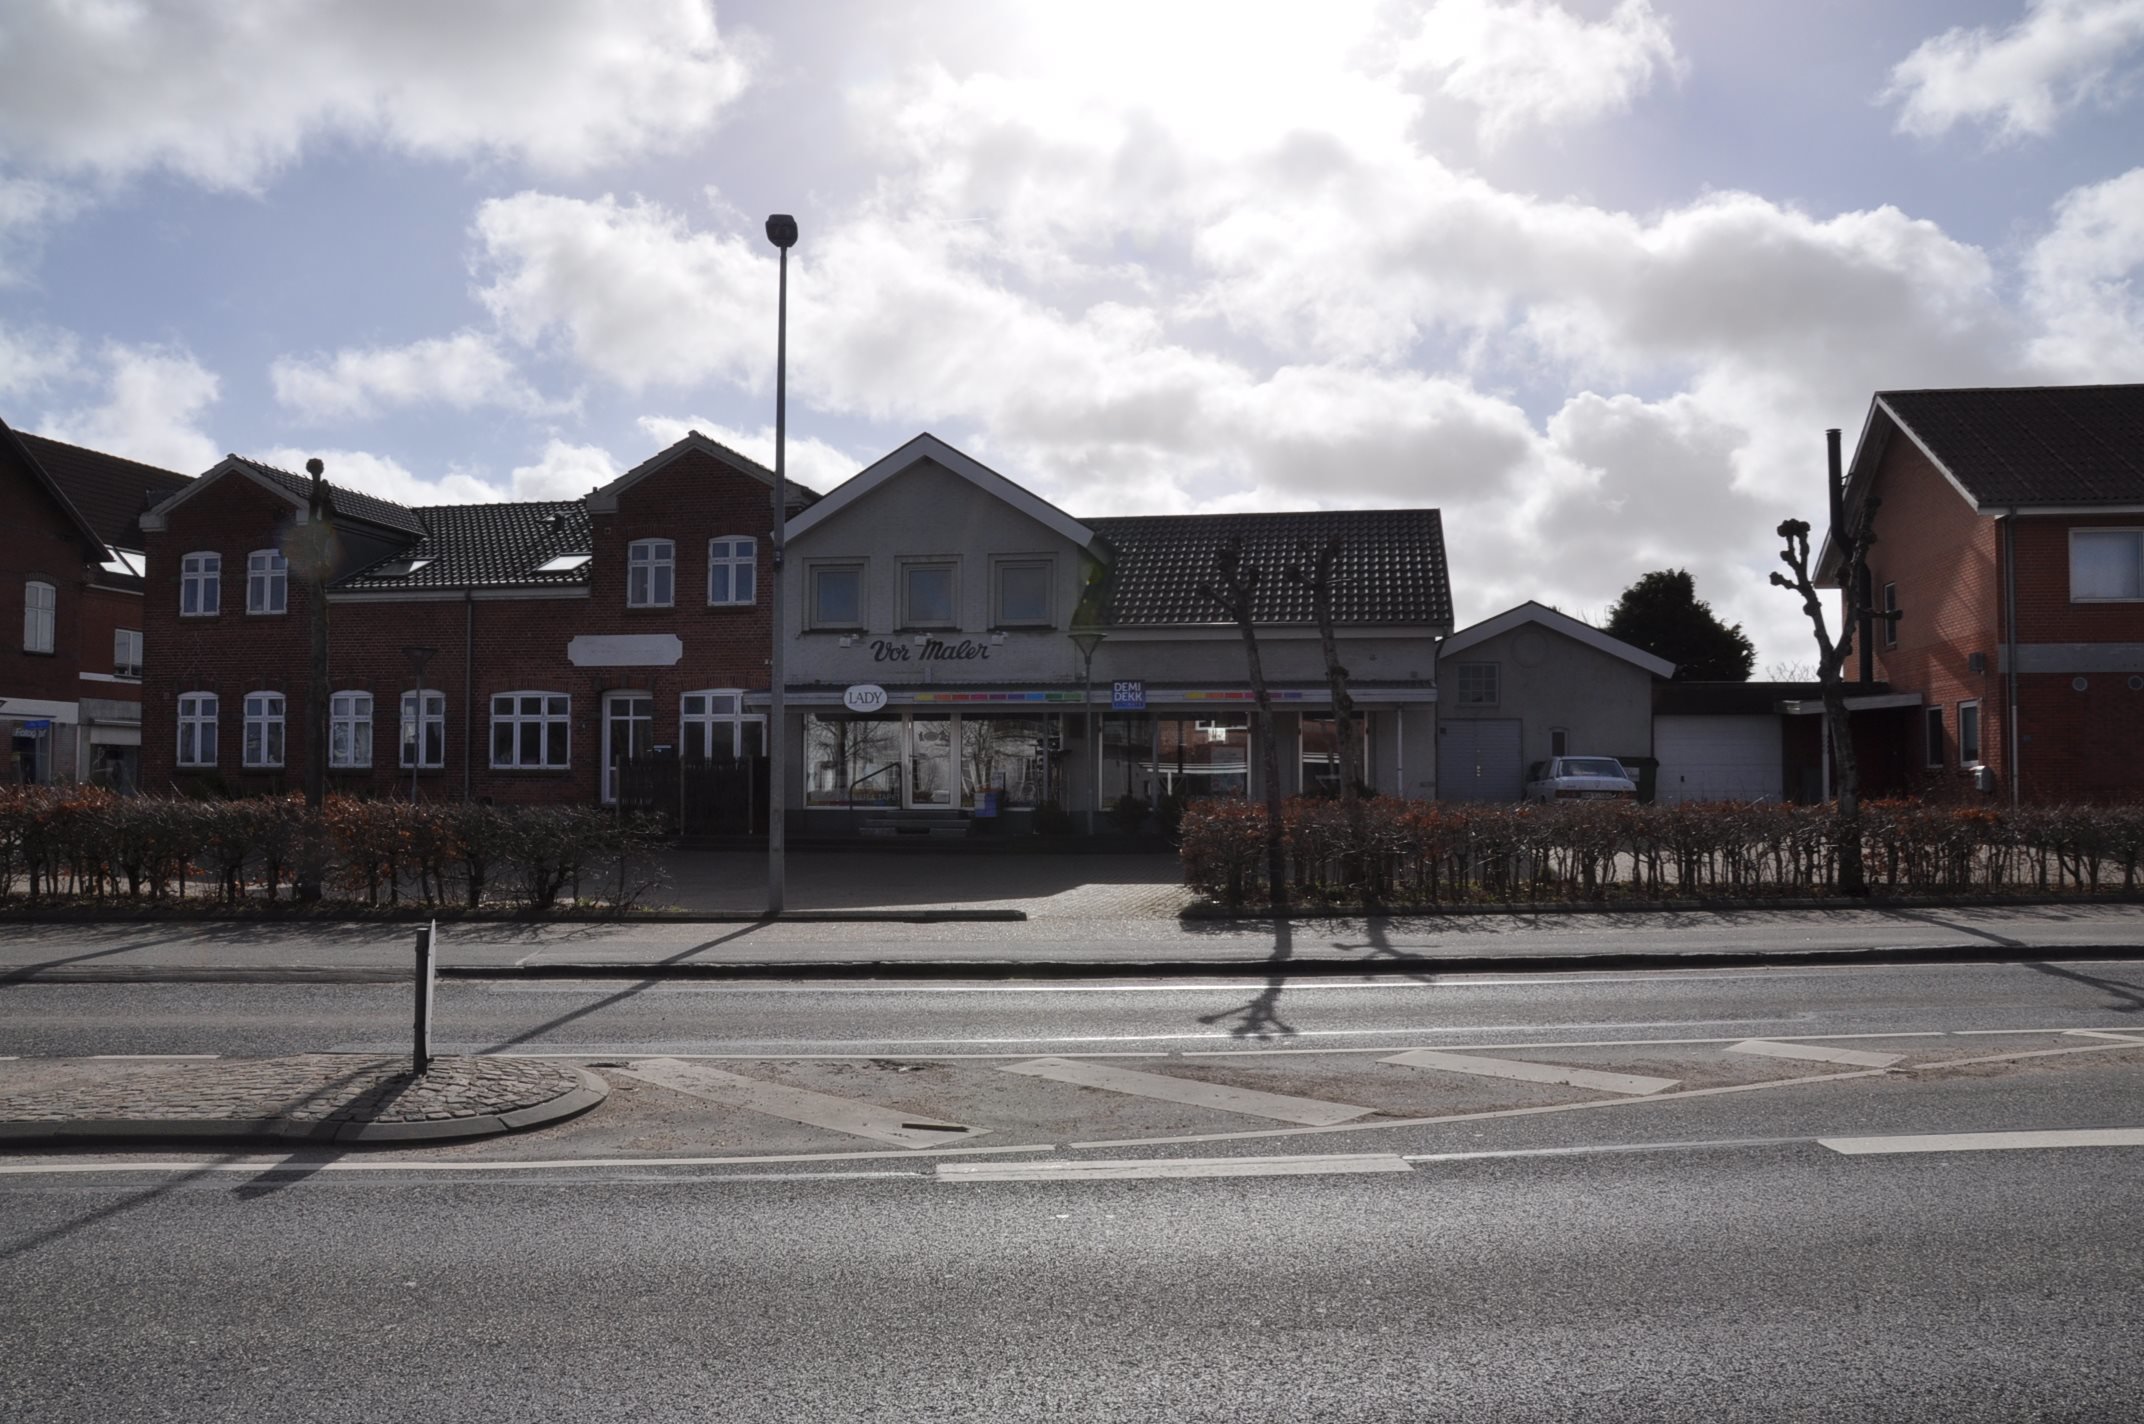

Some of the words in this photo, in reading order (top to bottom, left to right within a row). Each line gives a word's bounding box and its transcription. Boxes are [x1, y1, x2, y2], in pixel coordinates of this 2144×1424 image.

[870, 640, 911, 662] Vor
[918, 638, 990, 661] Maler
[1114, 682, 1141, 692] DEMI
[848, 692, 882, 704] LADY
[1114, 692, 1142, 702] DEKK
